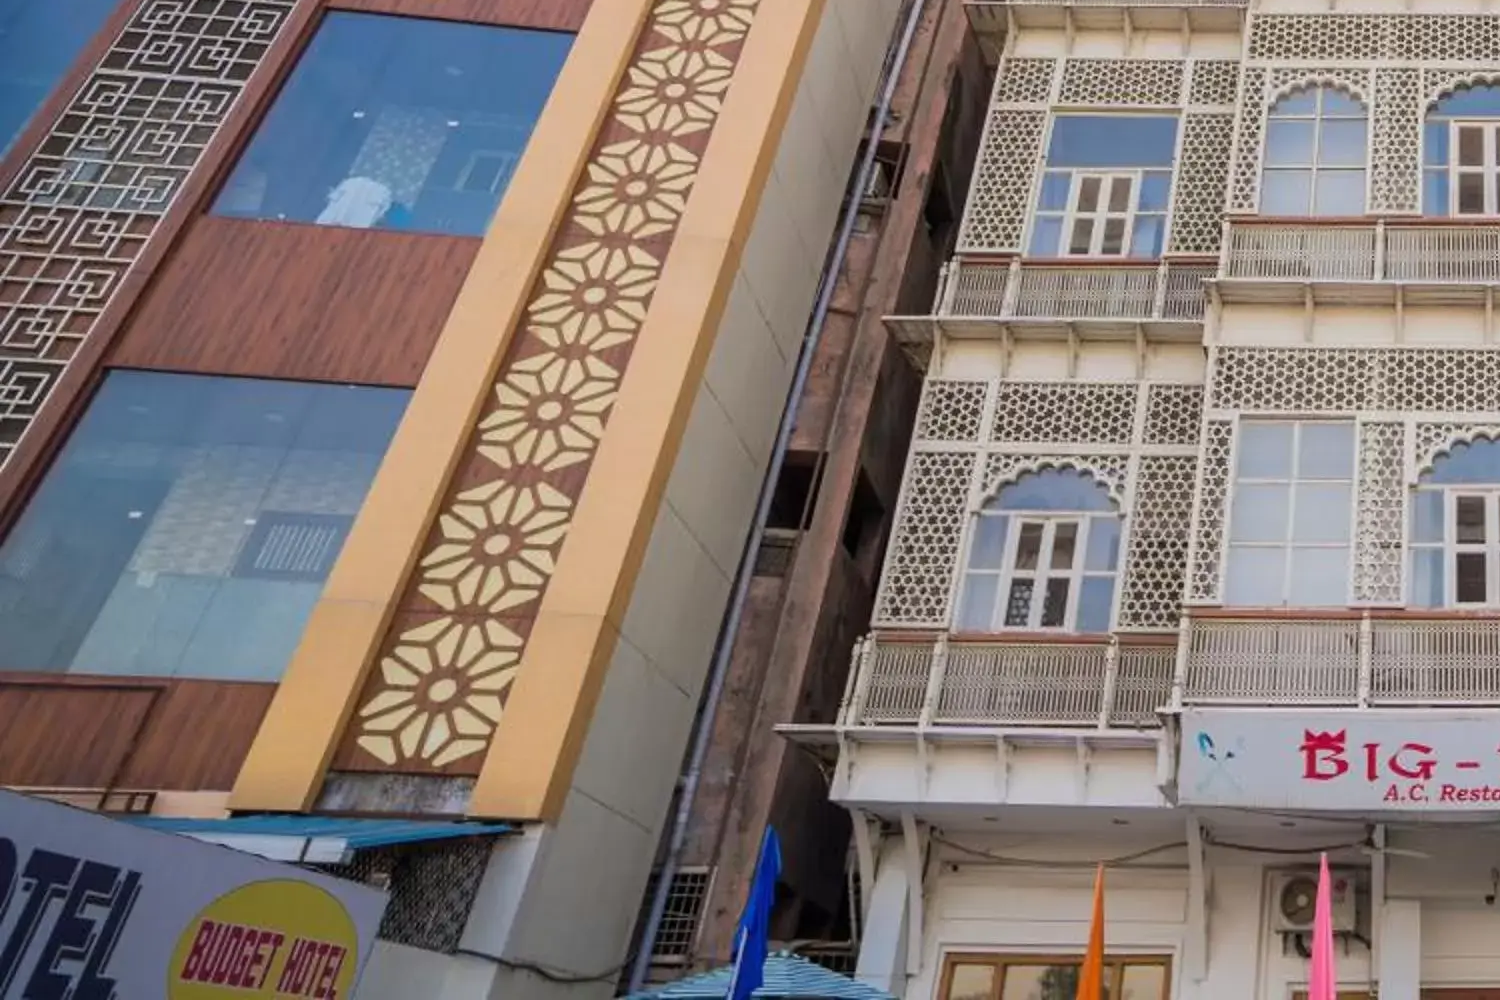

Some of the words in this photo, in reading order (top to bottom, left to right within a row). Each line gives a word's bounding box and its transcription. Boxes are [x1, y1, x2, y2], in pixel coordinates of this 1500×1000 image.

[1299, 742, 1438, 783] BIG
[179, 919, 286, 991] BUDGET
[275, 936, 348, 1000] HOTEL
